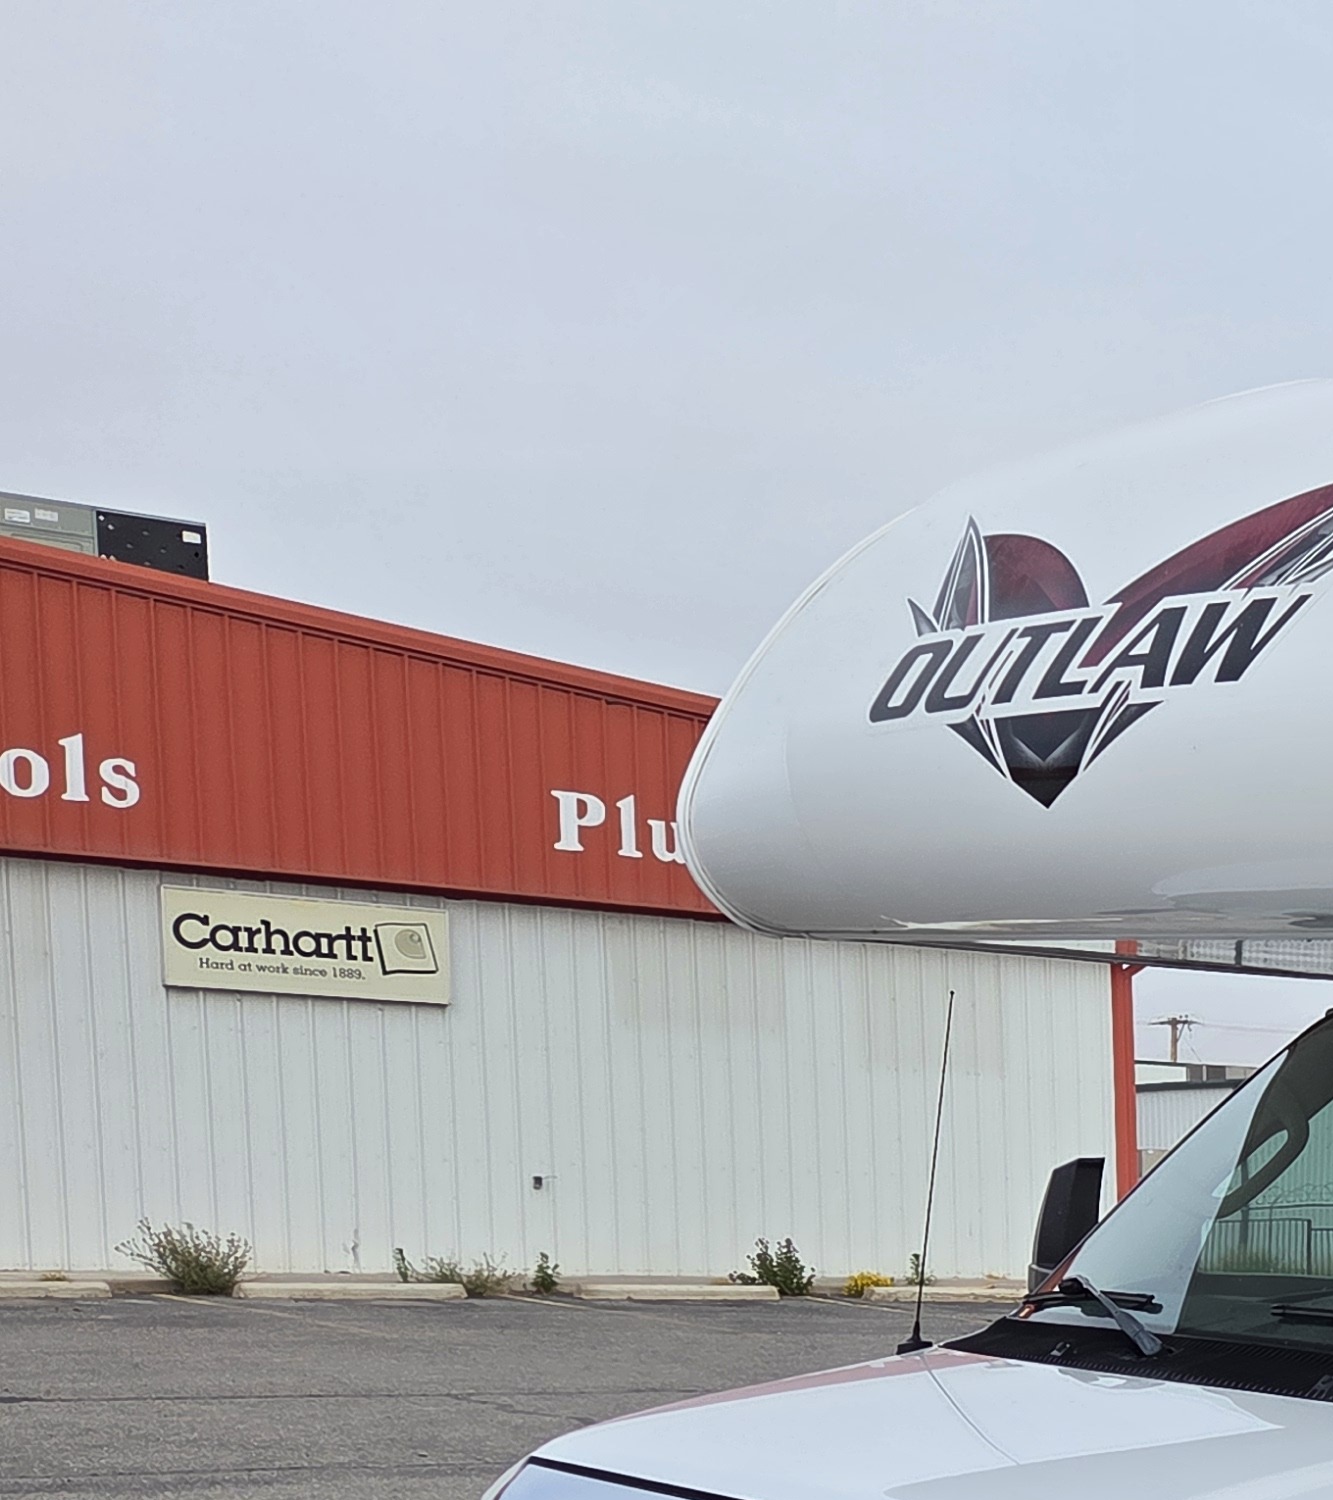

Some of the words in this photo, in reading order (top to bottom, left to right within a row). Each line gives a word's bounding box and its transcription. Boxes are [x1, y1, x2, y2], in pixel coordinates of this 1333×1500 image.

[868, 593, 1314, 724] OUTLAW
[0, 732, 140, 809] ols
[550, 789, 687, 865] Plu
[172, 912, 374, 962] Carhartt
[198, 957, 234, 972] Hard
[239, 962, 253, 973] at
[256, 962, 289, 975] work
[292, 965, 328, 978] since
